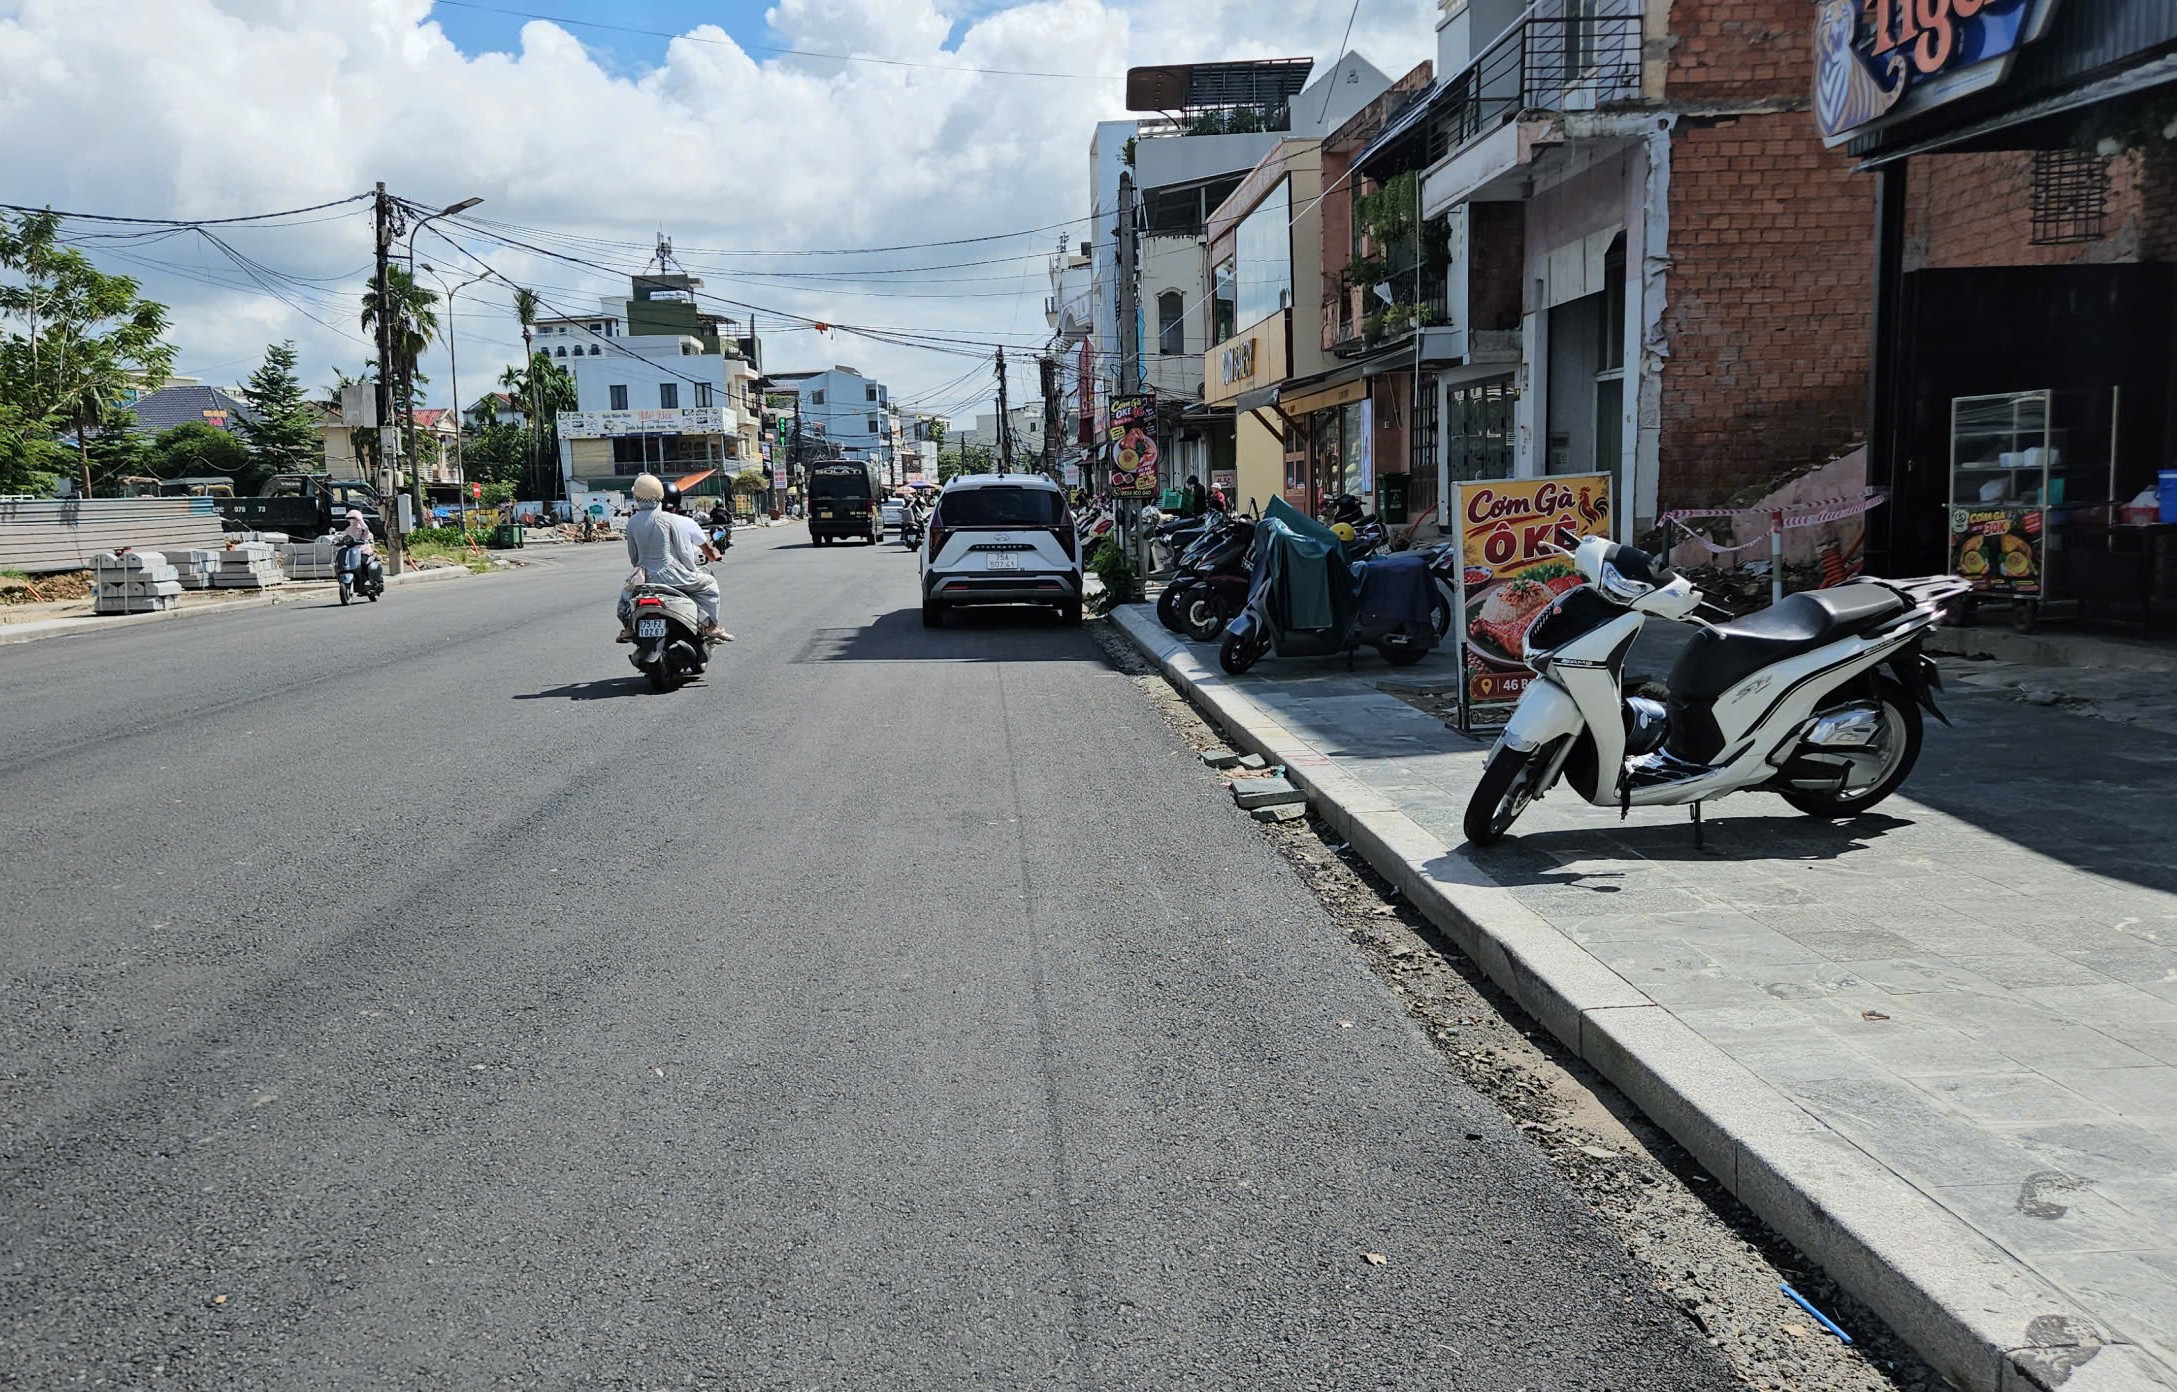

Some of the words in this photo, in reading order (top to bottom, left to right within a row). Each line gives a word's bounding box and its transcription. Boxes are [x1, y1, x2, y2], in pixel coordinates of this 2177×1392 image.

[1864, 0, 1997, 73] Tig
[1467, 488, 1531, 524] Cơm
[1534, 481, 1576, 517] Gà
[1484, 520, 1518, 565] Ô
[1503, 679, 1519, 691] 46
